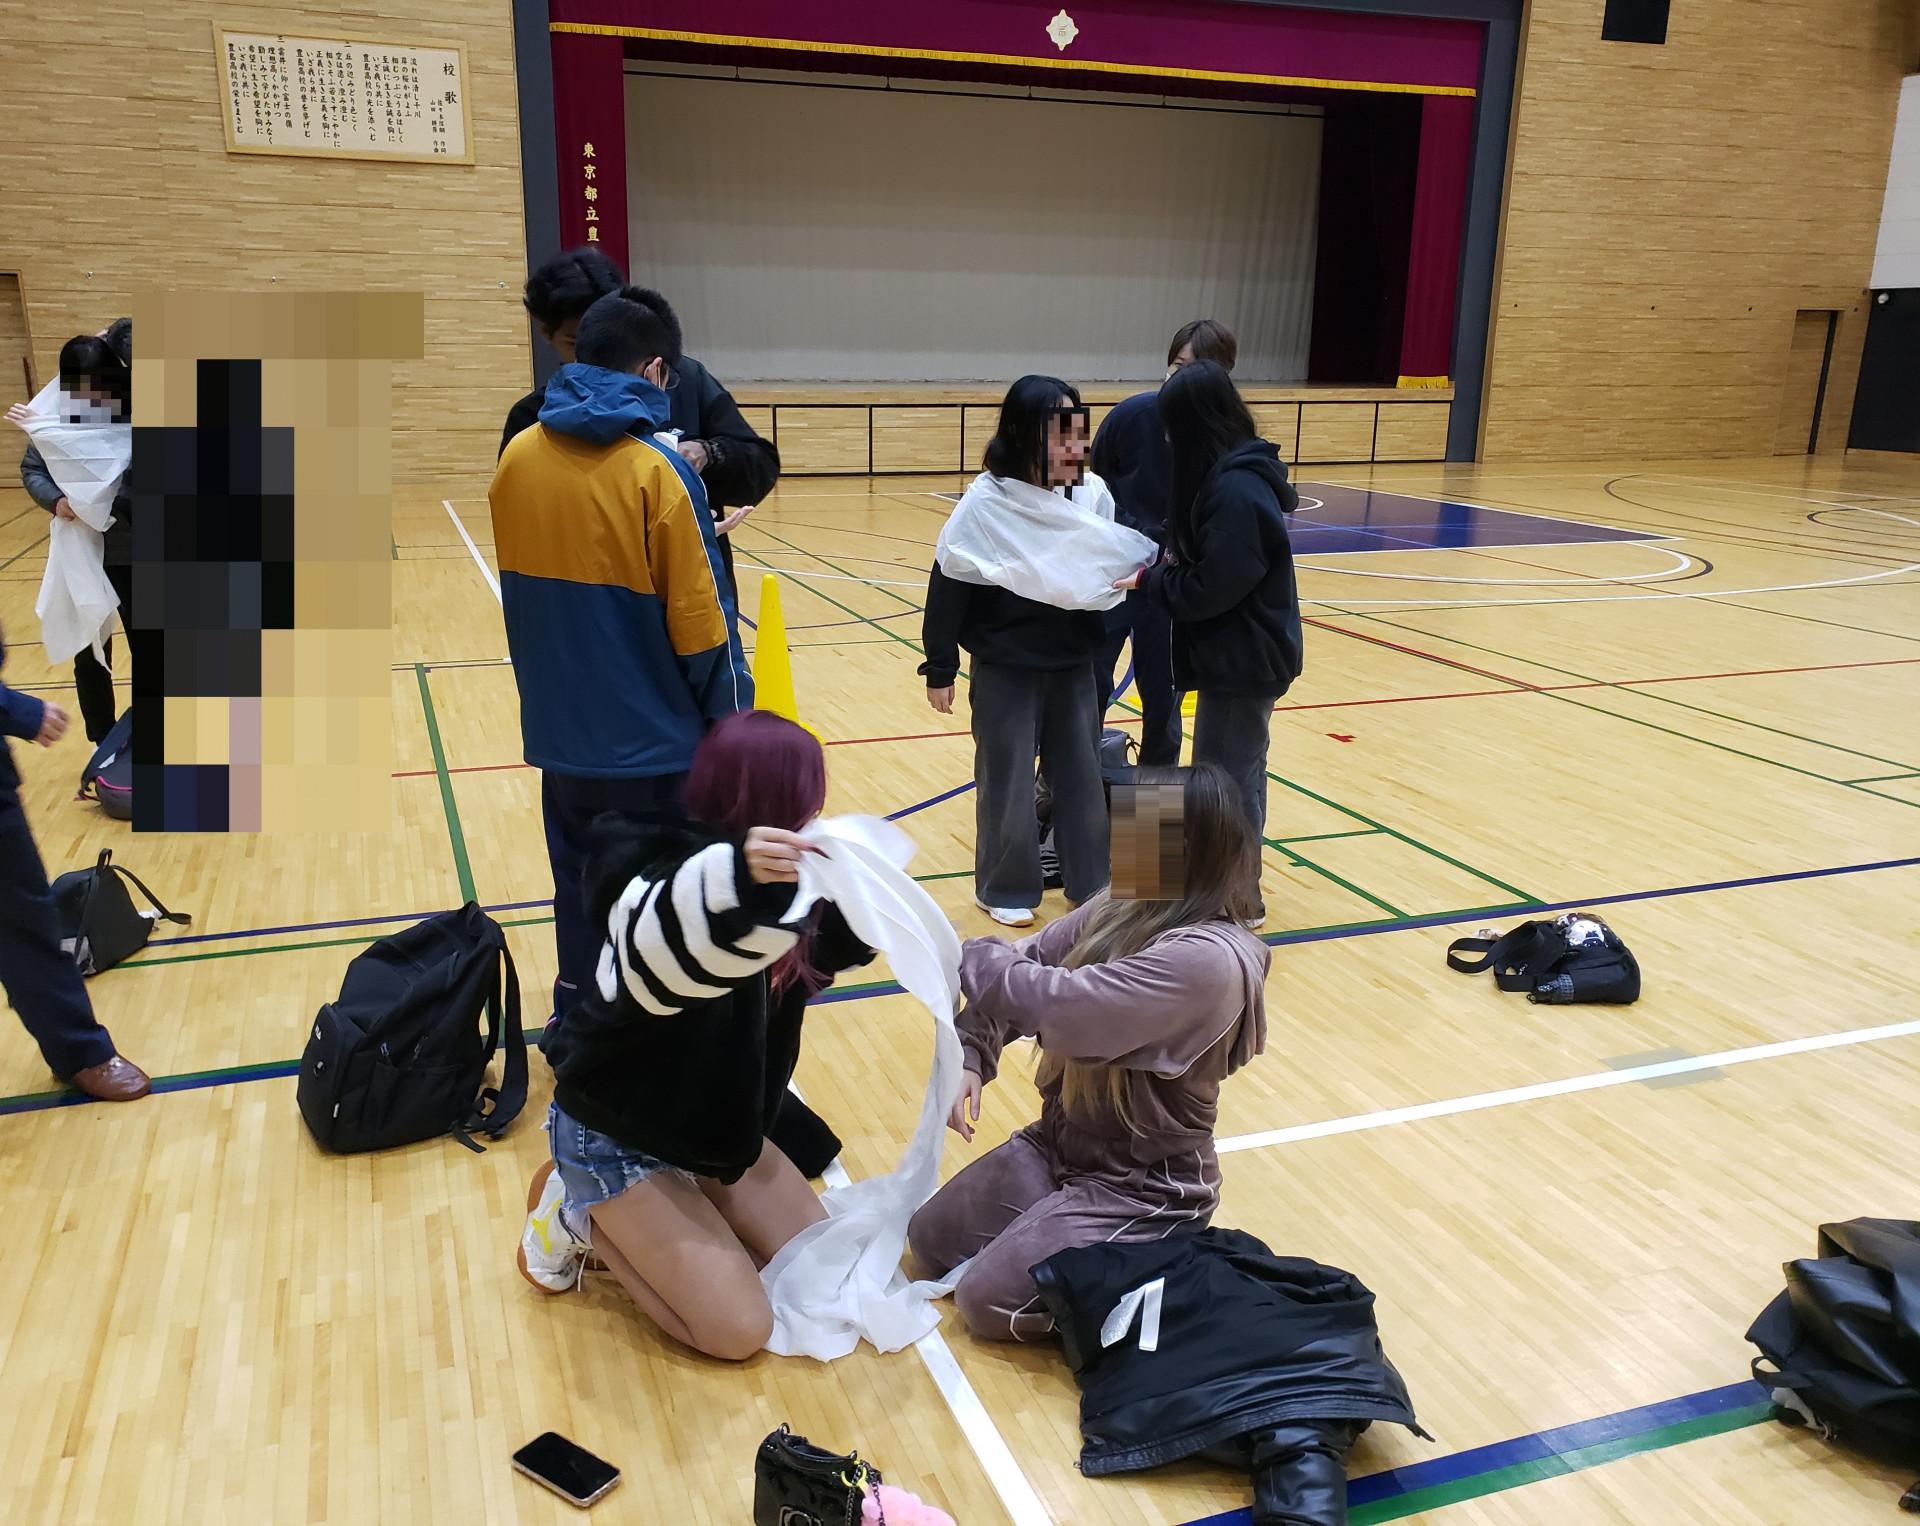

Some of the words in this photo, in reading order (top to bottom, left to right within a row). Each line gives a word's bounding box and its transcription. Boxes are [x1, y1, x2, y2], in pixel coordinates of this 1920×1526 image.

[238, 46, 250, 98] いざ我ら共に
[306, 51, 317, 102] いざ我ら共に
[372, 56, 383, 106] いざ我ら共に
[443, 62, 457, 104] 校歌
[430, 99, 436, 112] 山田
[583, 142, 600, 242] 東京都立豊
